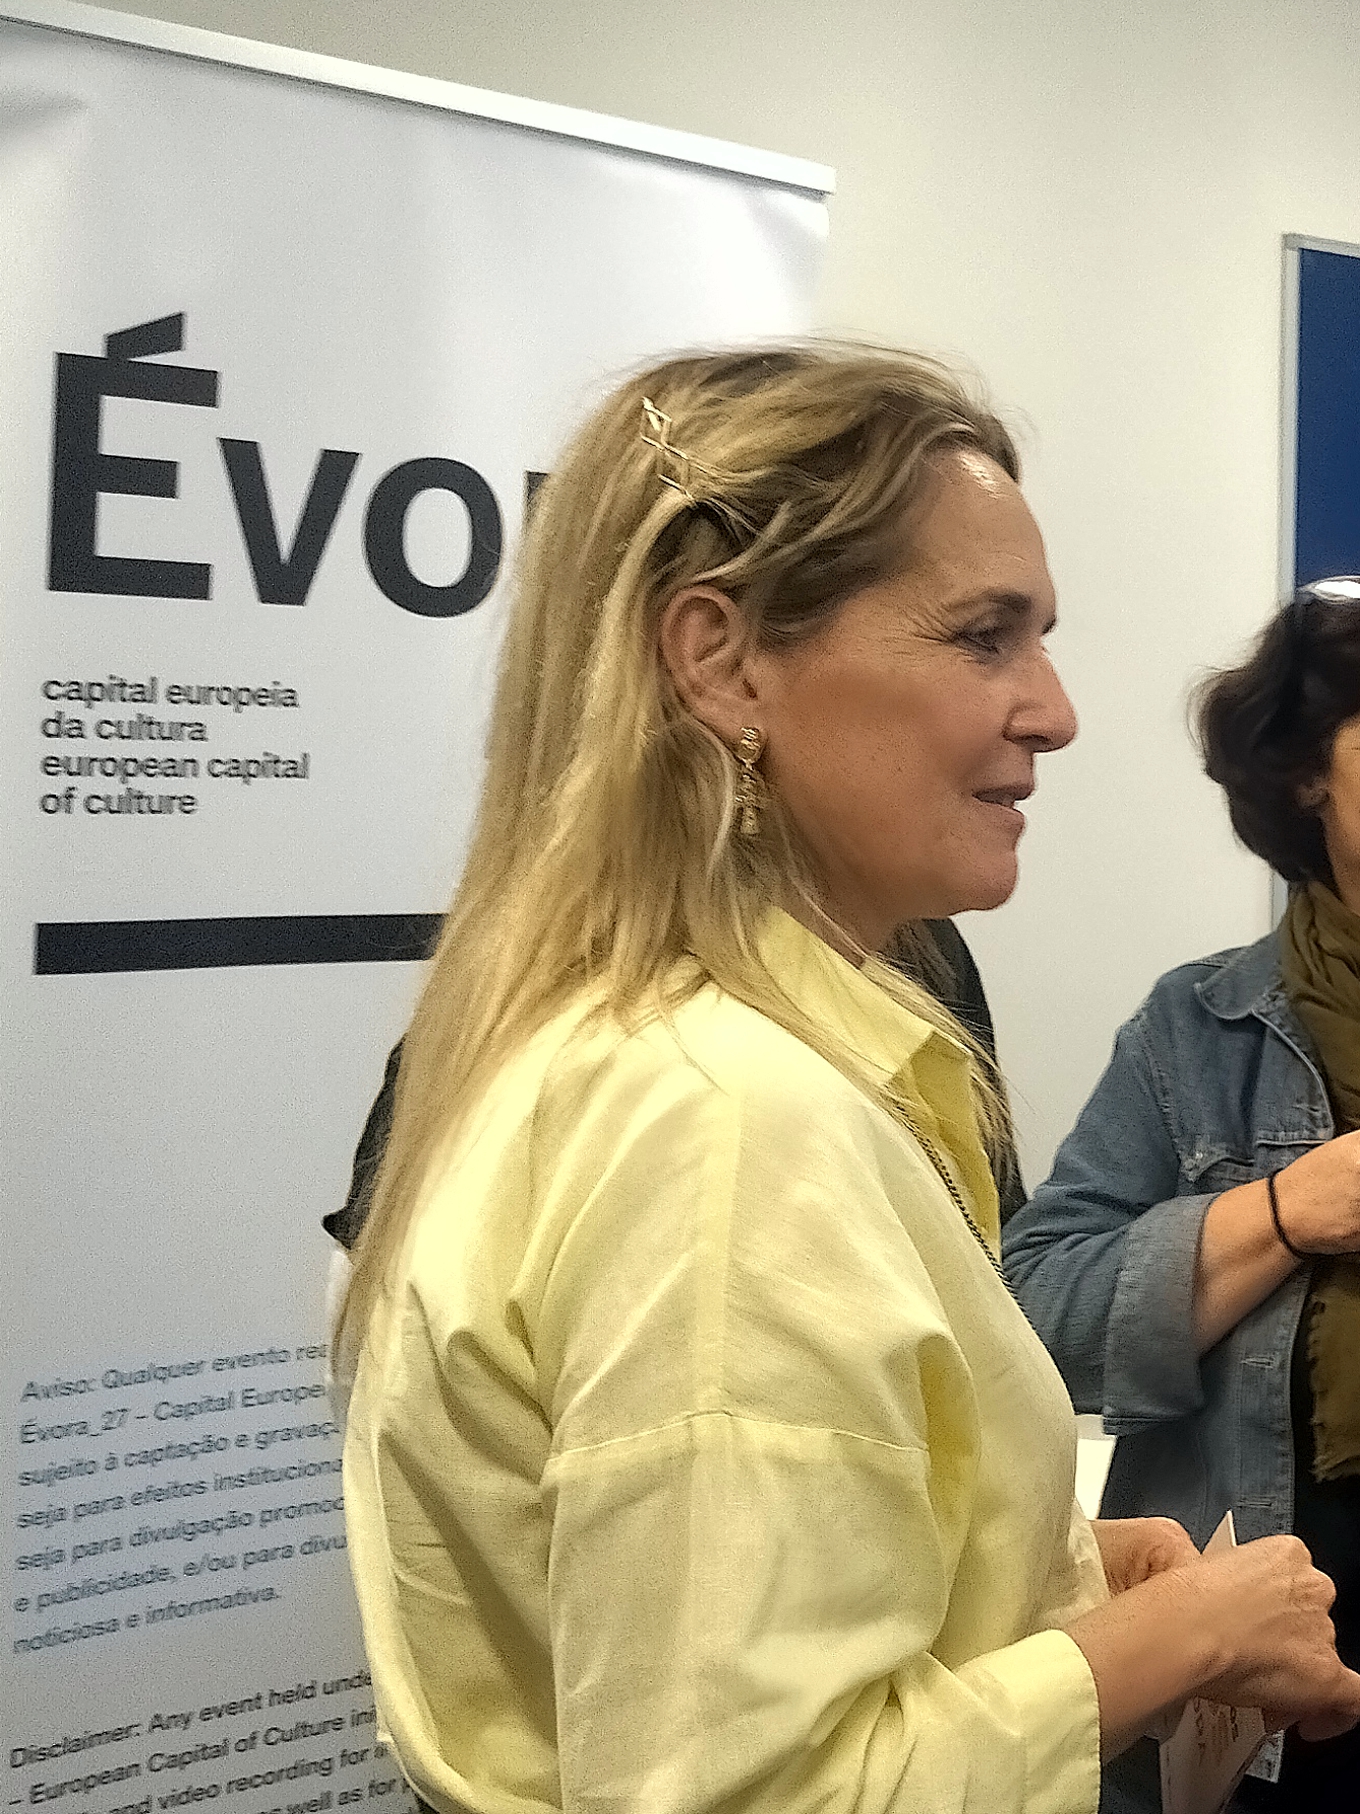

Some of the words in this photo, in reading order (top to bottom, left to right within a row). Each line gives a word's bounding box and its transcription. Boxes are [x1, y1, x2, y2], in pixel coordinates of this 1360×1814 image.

[48, 312, 556, 618] Évo
[40, 674, 158, 709] capital
[165, 681, 299, 713] europeia
[40, 710, 86, 740] da
[94, 712, 208, 742] cultura
[40, 755, 200, 785] european
[206, 751, 310, 785] capital
[39, 786, 78, 814] of
[83, 786, 198, 814] culture
[102, 1359, 208, 1390] Qualquer
[212, 1347, 290, 1372] evento
[153, 1390, 235, 1421] Capital
[18, 1457, 98, 1488] sujeito
[124, 1433, 229, 1468] captação
[234, 1434, 249, 1448] e
[17, 1504, 67, 1529] seja
[73, 1496, 125, 1522] para
[130, 1480, 208, 1506] efeitos
[15, 1547, 66, 1571] seja
[72, 1536, 123, 1565] para
[129, 1509, 256, 1548] divulgação
[14, 1597, 30, 1612] e
[243, 1544, 294, 1571] para
[13, 1617, 120, 1653] noticiosa
[126, 1613, 140, 1628] e
[149, 1712, 194, 1732] Any
[199, 1691, 262, 1721] event
[269, 1679, 317, 1708] held
[30, 1762, 141, 1805] European
[148, 1738, 230, 1773] Capital
[235, 1729, 260, 1753] of
[263, 1716, 346, 1747] Culture
[157, 1783, 220, 1810] video
[226, 1756, 333, 1795] recording
[340, 1747, 369, 1769] for
[338, 1786, 363, 1806] as
[368, 1776, 397, 1799] for
